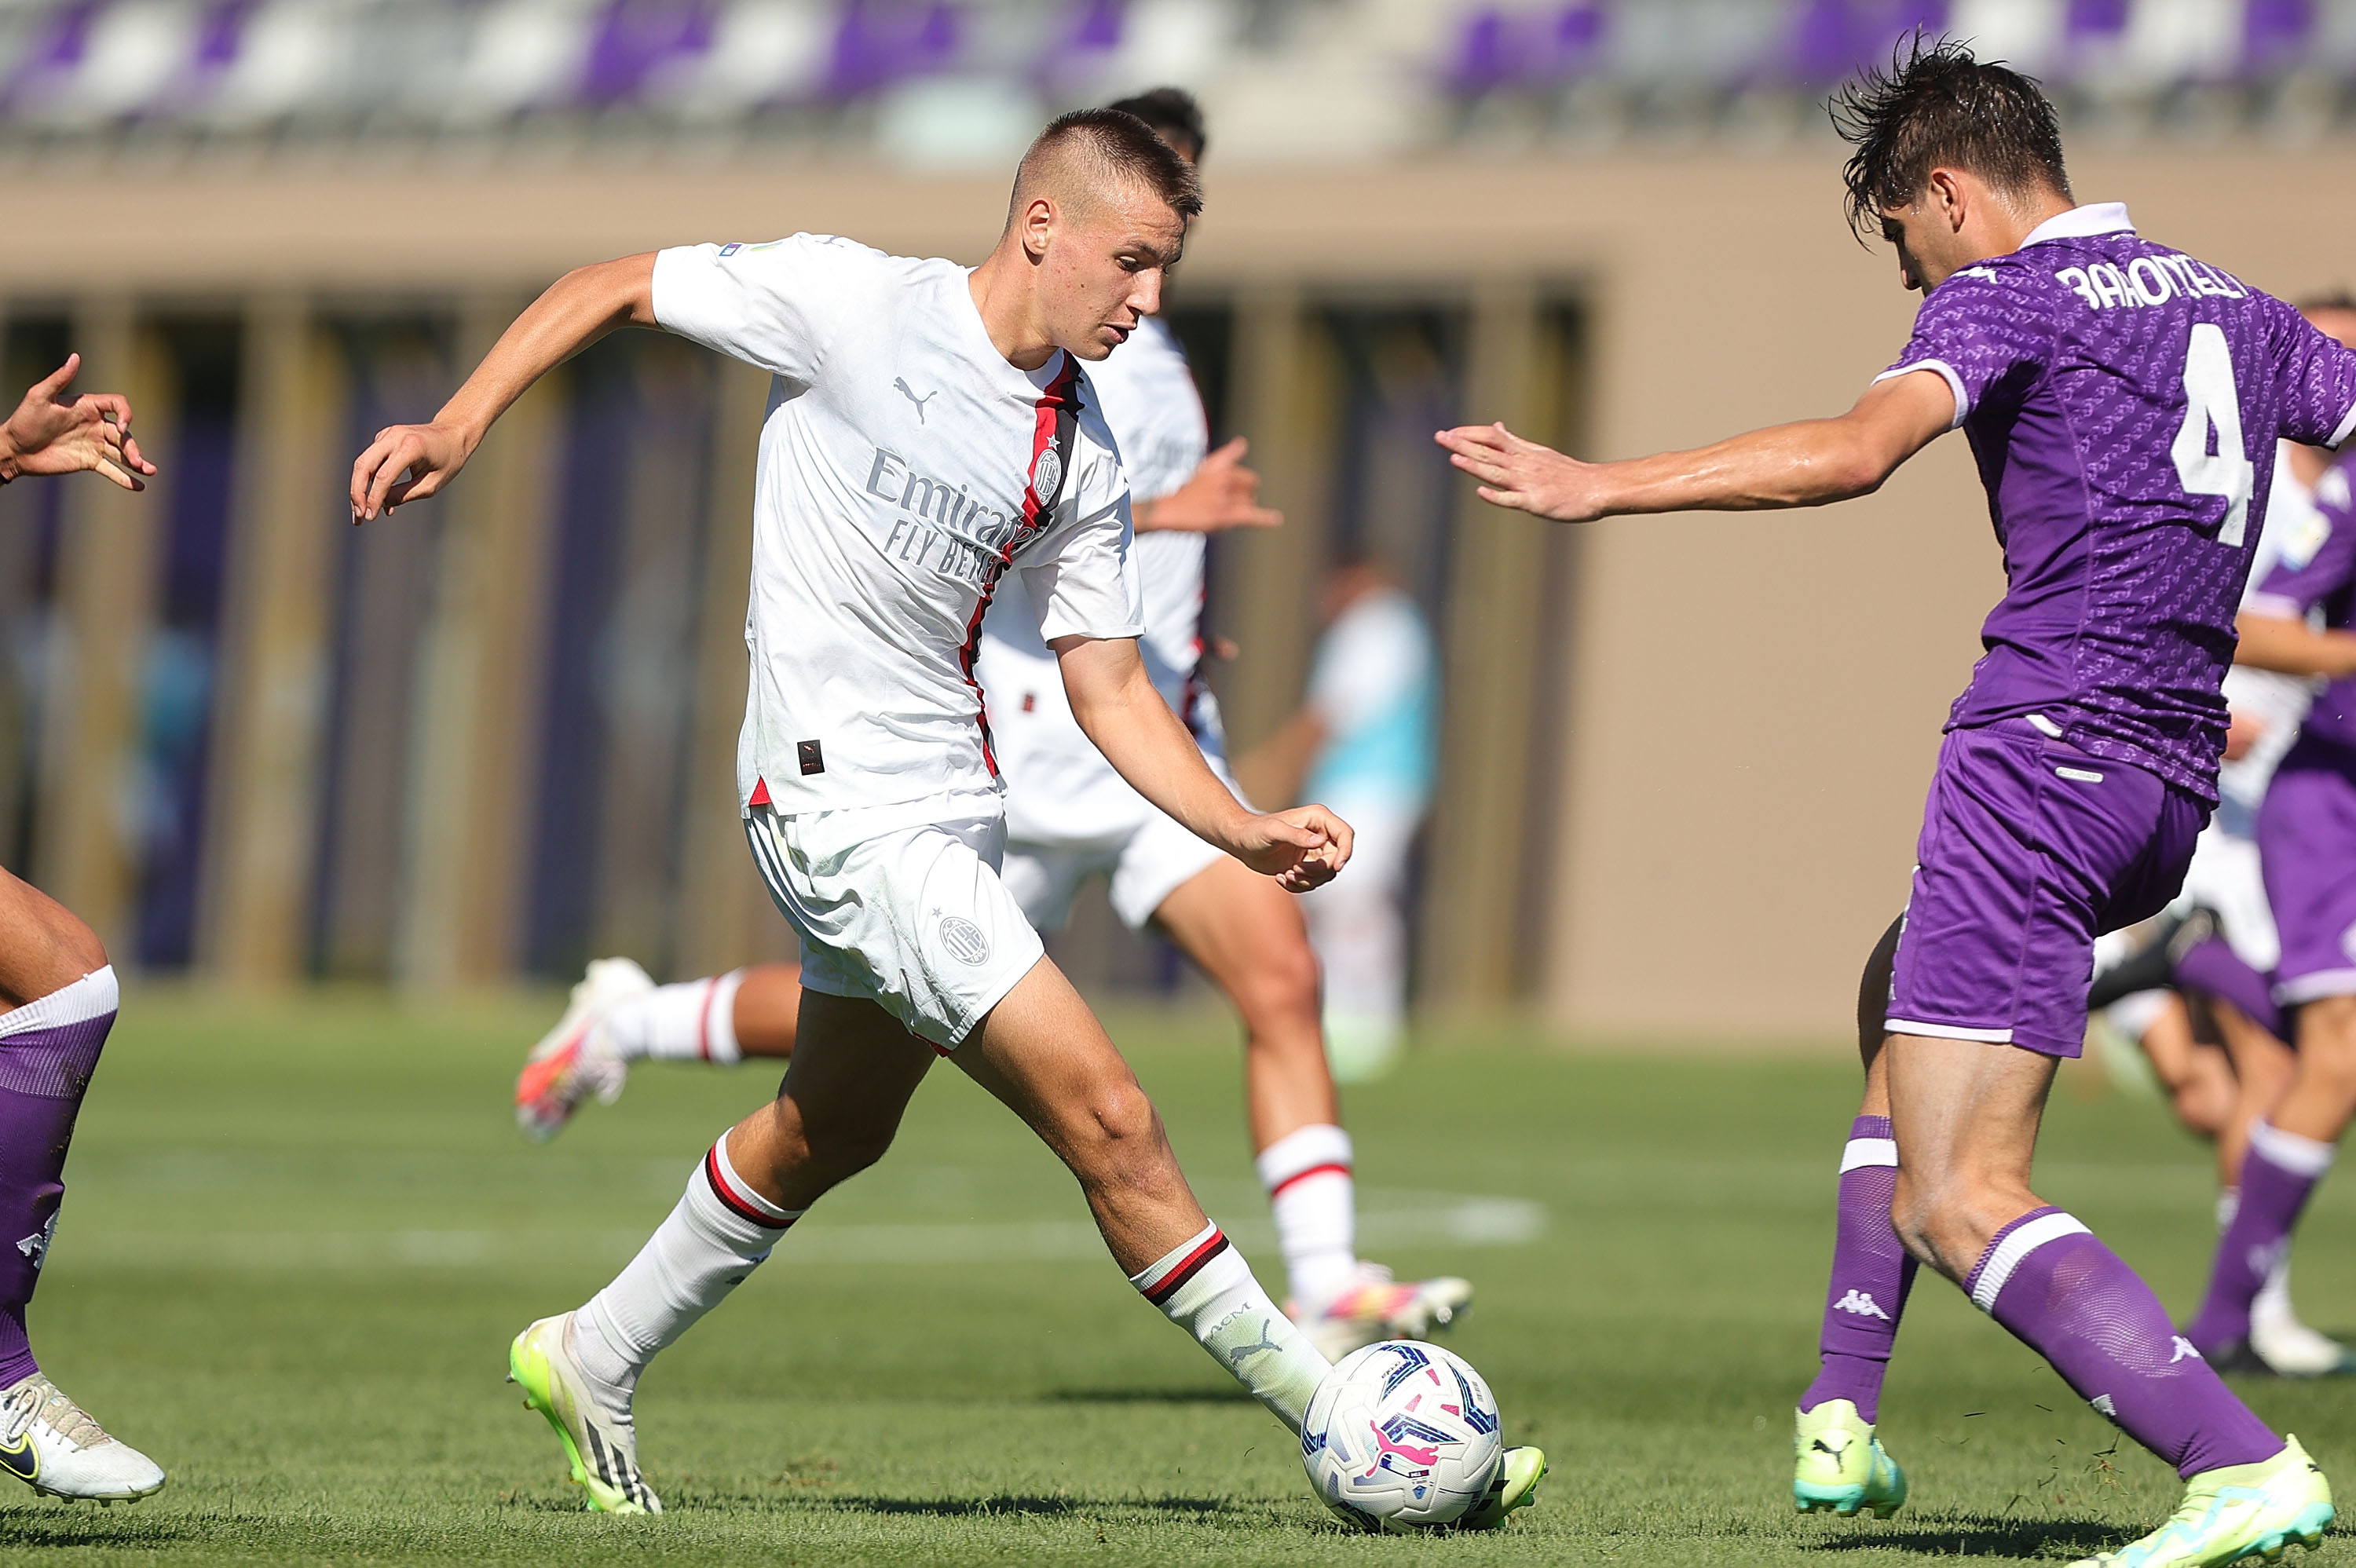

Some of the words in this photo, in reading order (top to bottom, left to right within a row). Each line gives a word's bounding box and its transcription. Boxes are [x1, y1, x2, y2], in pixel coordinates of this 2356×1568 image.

[2171, 322, 2254, 547] 4
[884, 518, 939, 566] FLY
[1209, 1302, 1253, 1340] ACM
